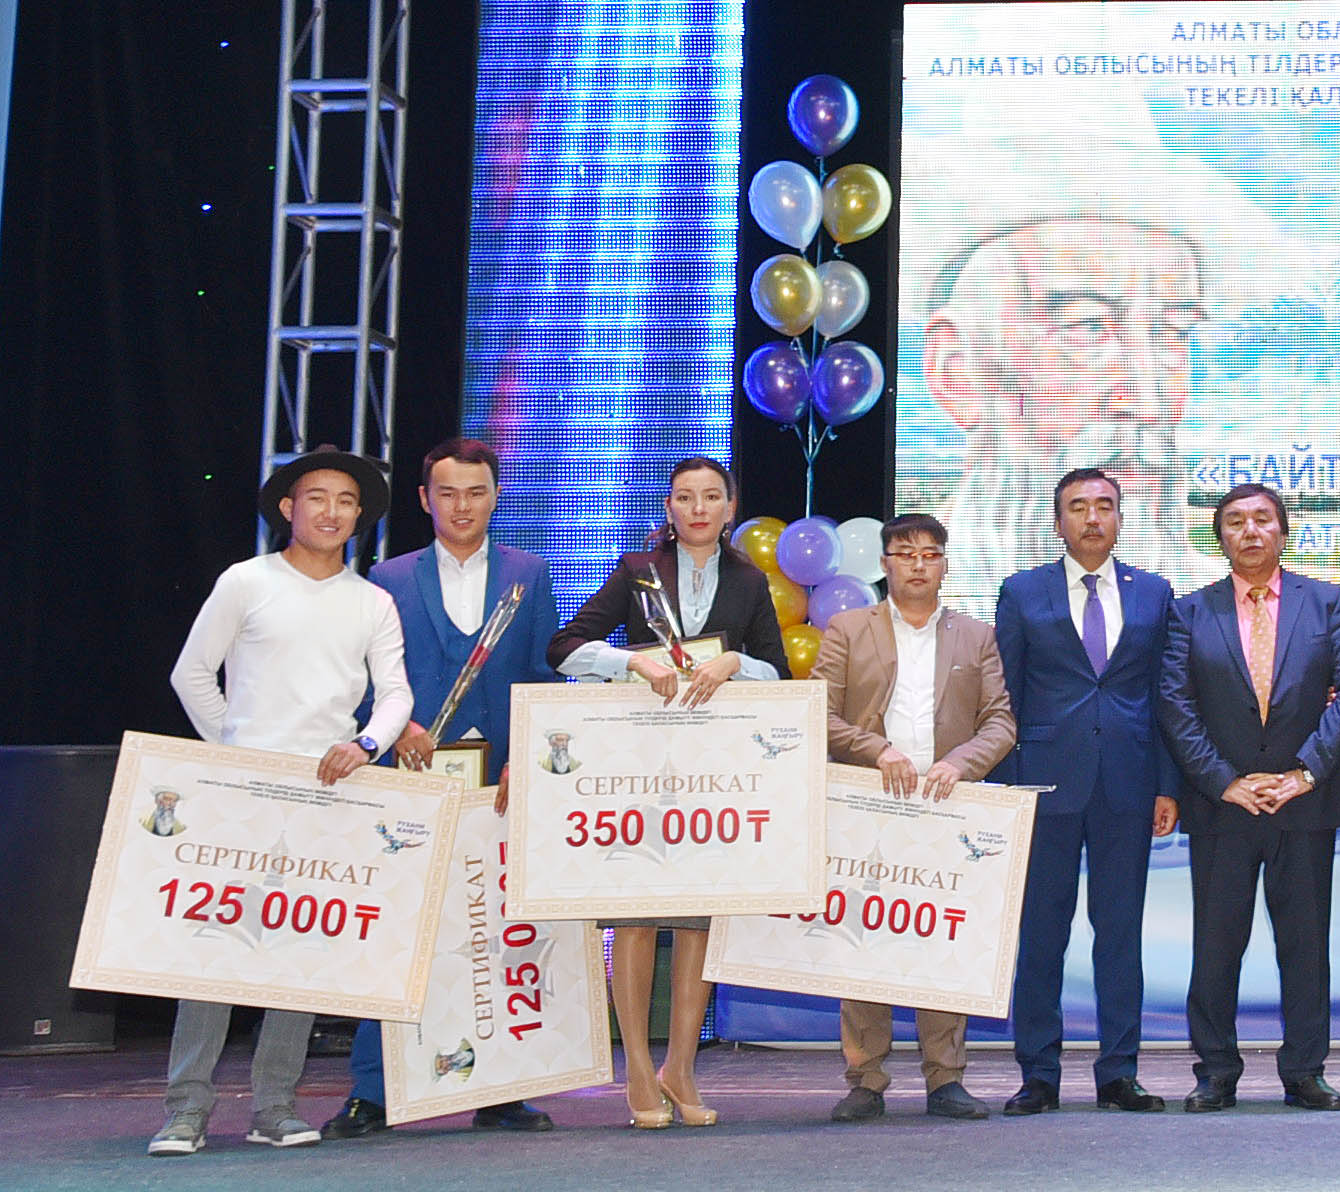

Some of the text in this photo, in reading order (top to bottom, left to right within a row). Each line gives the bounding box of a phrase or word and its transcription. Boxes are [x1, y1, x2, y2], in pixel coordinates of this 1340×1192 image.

[1171, 21, 1286, 41] АЛМАТЫ
[929, 56, 1043, 77] АЛМАТЫ
[1056, 54, 1238, 77] ОБЛЫСЫНЫҢ
[1186, 86, 1279, 107] ТЕКЕЛІ
[575, 773, 763, 796] СЕРТИФИКАТ
[565, 810, 645, 847] 350
[174, 842, 380, 886] СЕРТИФИКАТ
[826, 856, 964, 891] ТИФИКАТ
[158, 878, 247, 926] 125
[464, 854, 495, 1041] СЕРТИФИКАТ
[504, 962, 543, 1041] 125
